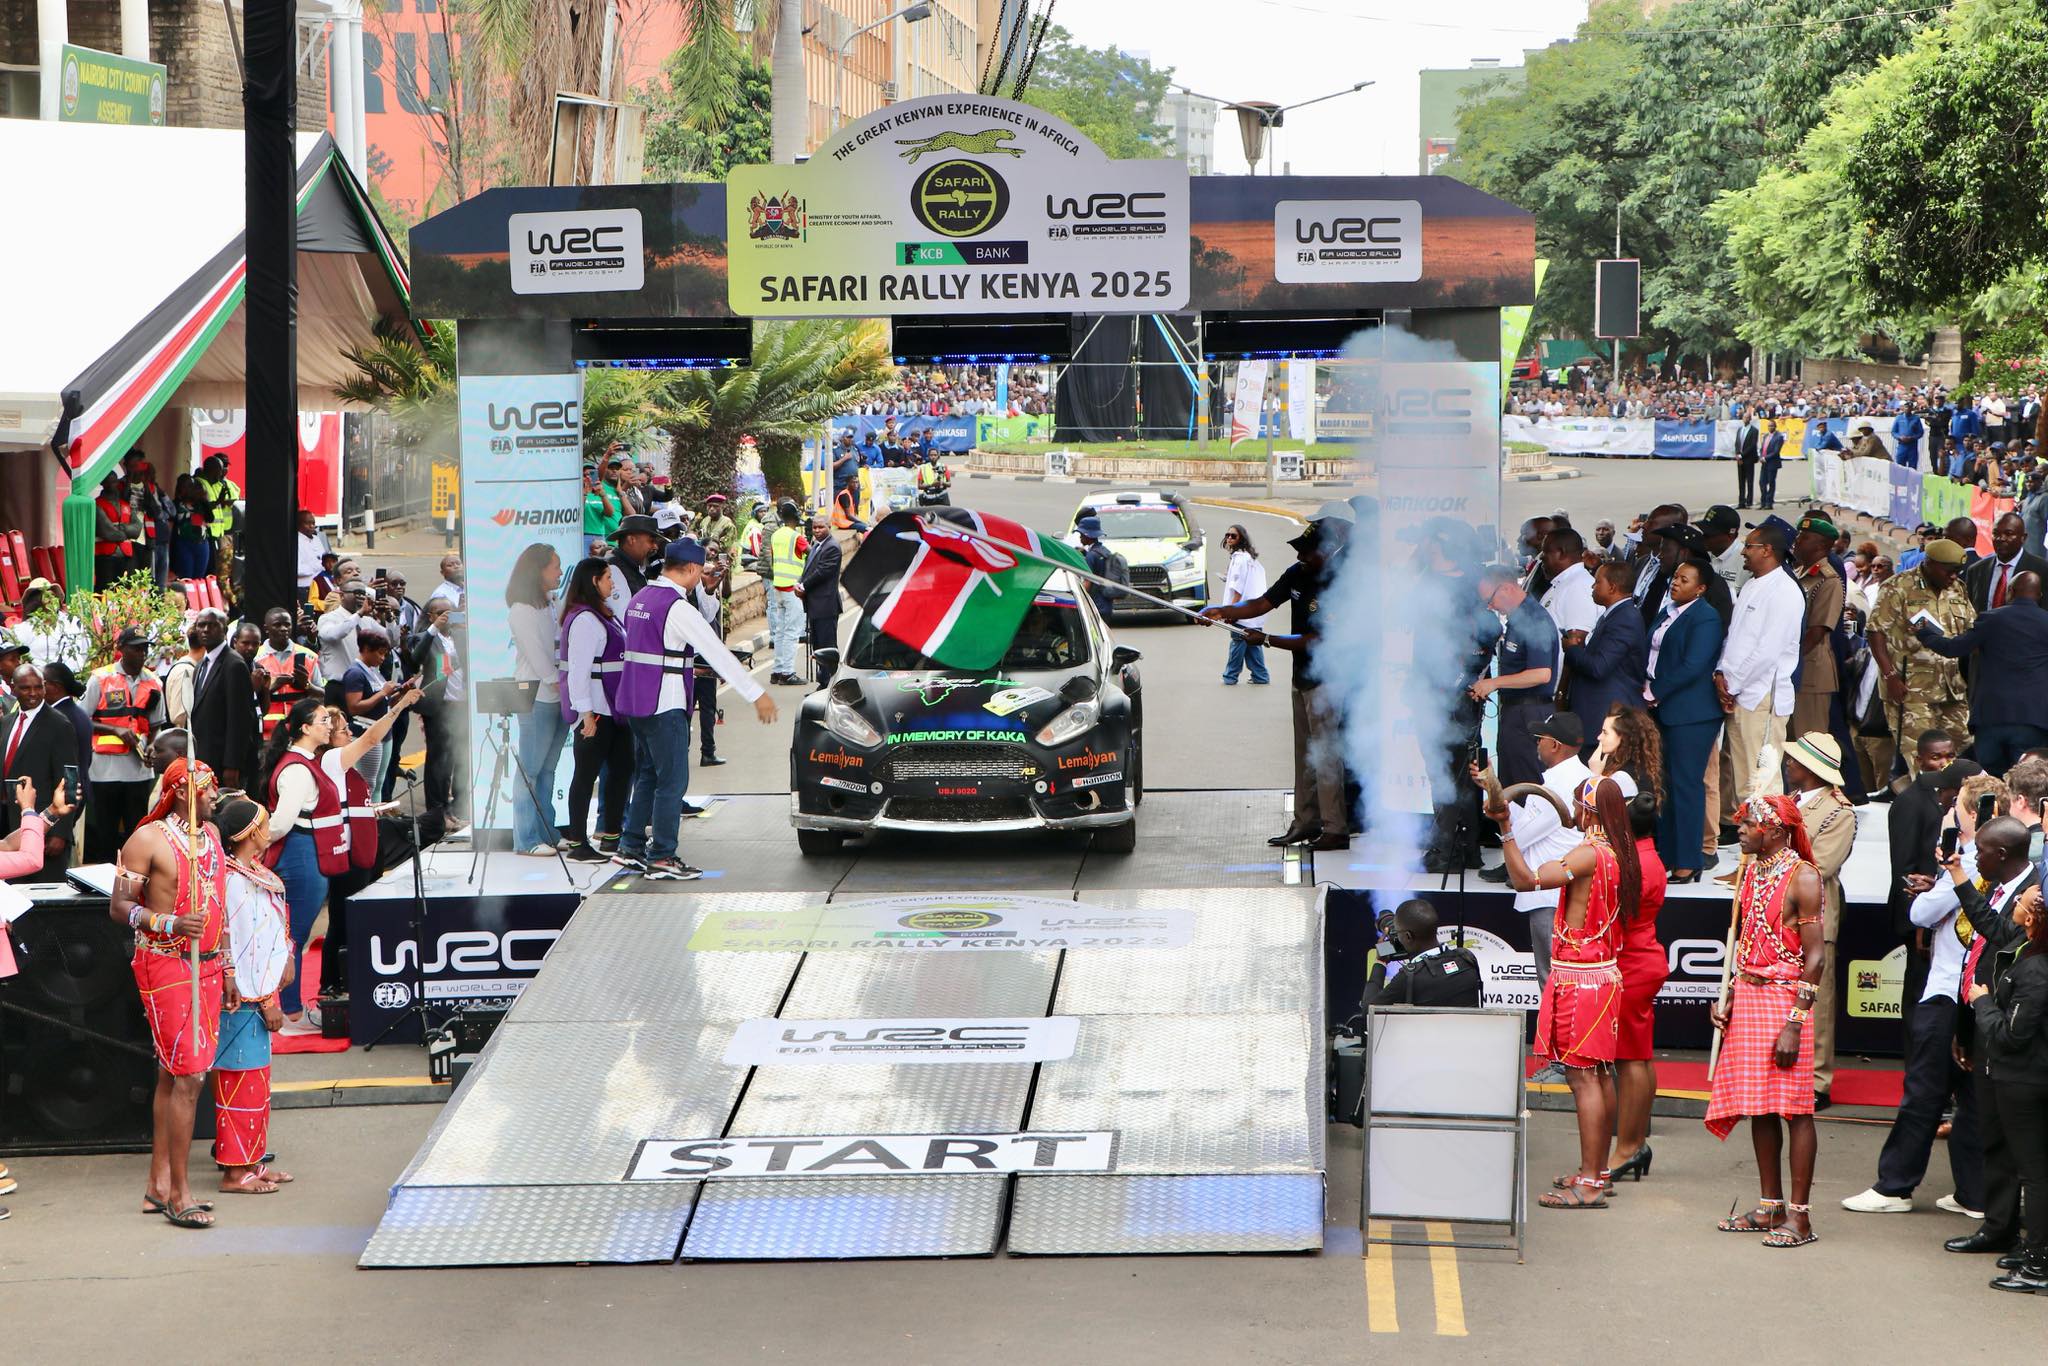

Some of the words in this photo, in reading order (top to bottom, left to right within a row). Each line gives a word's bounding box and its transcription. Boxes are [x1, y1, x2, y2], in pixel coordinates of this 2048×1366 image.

[80, 62, 108, 89] NAIROBI
[108, 68, 124, 92] CITY
[124, 71, 151, 96] COUNTY
[96, 100, 133, 124] ASSEMBLY
[832, 141, 856, 161] THE
[856, 119, 893, 146] GREAT
[894, 104, 943, 126] KENYAN
[947, 103, 1024, 125] EXPERIENCE
[1024, 117, 1039, 131] IN
[1038, 125, 1080, 157] AFRICA
[935, 178, 985, 188] SAFARI
[938, 209, 981, 219] RALLY
[1046, 192, 1166, 219] WRC
[1296, 217, 1402, 243] WRC
[528, 226, 624, 255] WRC
[920, 248, 943, 260] KCB
[976, 247, 1010, 259] BANK
[760, 275, 867, 302] SAFARI
[879, 274, 971, 300] RALLY
[981, 272, 1080, 300] KENYA
[1091, 270, 1172, 298] 2025
[887, 732, 902, 745] IN
[903, 730, 963, 743] MEMORY
[966, 730, 985, 741] OF
[987, 730, 1027, 743] KAKA
[722, 939, 840, 949] SAFARI
[851, 939, 951, 948] RALLY
[961, 938, 1068, 948] KENYA
[1082, 936, 1169, 946] 2025
[375, 984, 410, 1006] FIA
[446, 984, 502, 992] WORLD
[1507, 993, 1539, 1005] 2025
[1860, 1001, 1900, 1014] SAFAR
[781, 1026, 1030, 1043] WRC
[660, 1136, 1088, 1175] START
